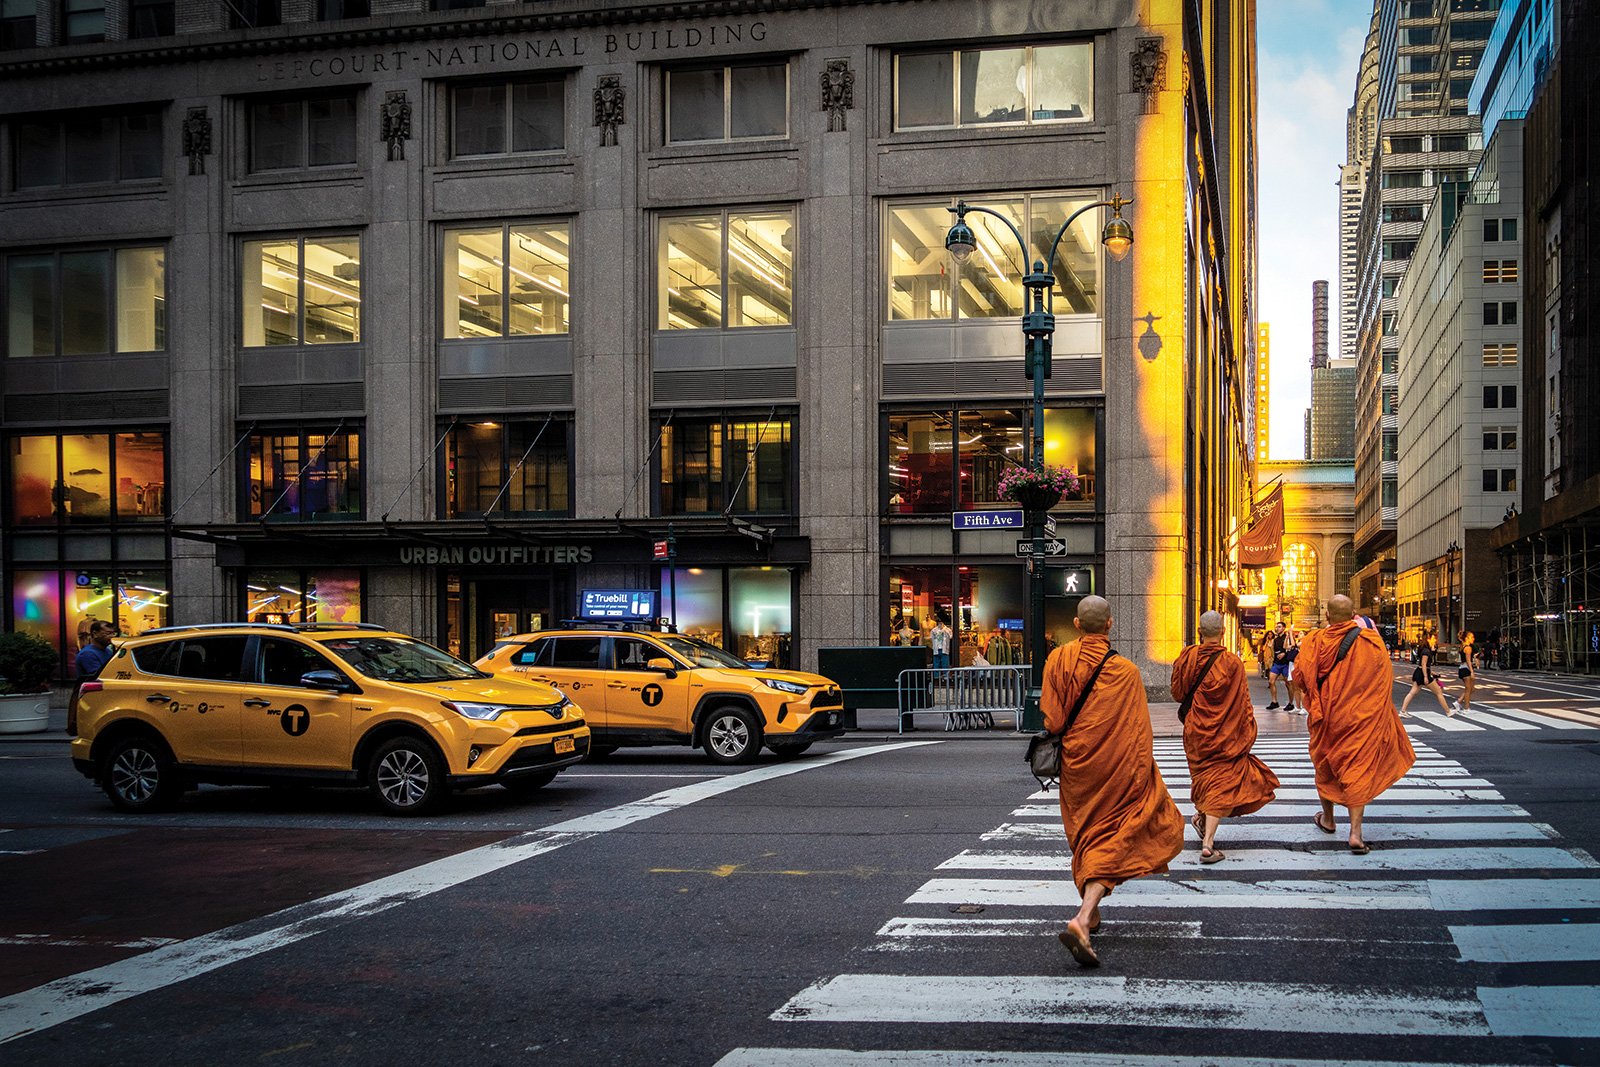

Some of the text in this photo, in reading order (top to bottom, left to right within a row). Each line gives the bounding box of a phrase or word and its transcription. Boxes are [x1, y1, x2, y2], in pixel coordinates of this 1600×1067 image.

[257, 22, 767, 82] LEFCOURT-NATIONAL BUILDING
[963, 515, 1013, 526] Fifth Ave
[1244, 543, 1278, 552] EQUINOX
[400, 546, 593, 565] URBAN OUTFITTERS
[594, 594, 628, 603] Truebill
[288, 710, 305, 733] T
